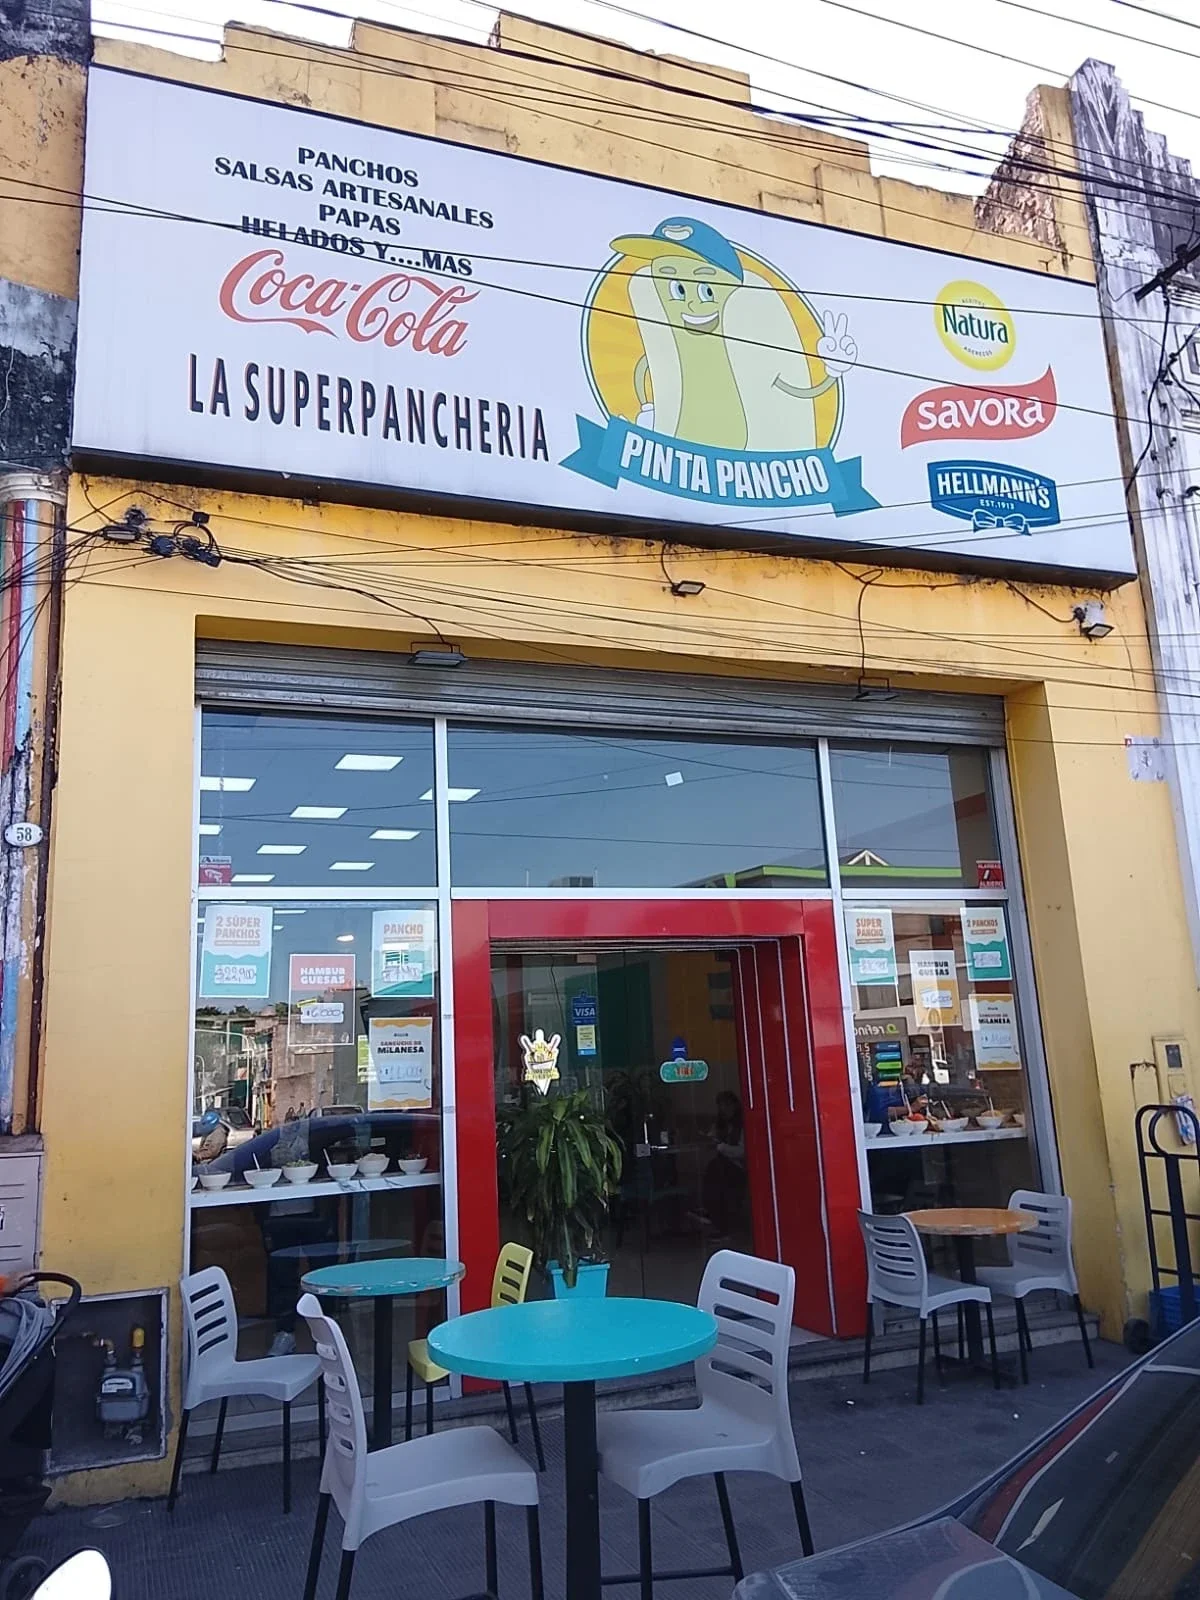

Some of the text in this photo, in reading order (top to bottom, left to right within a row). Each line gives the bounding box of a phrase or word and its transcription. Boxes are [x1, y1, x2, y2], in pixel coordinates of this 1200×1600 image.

[298, 147, 419, 187] PANCHOS
[214, 157, 494, 229] SALSAS ARTESANALES
[319, 204, 401, 235] PAPAS
[241, 216, 365, 255] HELADOS
[942, 303, 1009, 344] Natura
[188, 353, 549, 462] LA SUPERPANCHERIA
[620, 431, 830, 499] PINTA PANCHO
[937, 471, 1051, 509] HELLMANN'S
[16, 827, 32, 841] 58
[215, 916, 223, 927] 2
[215, 928, 260, 939] PANCHOS
[383, 923, 423, 934] PANCHO
[856, 928, 884, 937] PANCHO
[972, 919, 998, 927] PANCHOS
[575, 1007, 595, 1017] VISA
